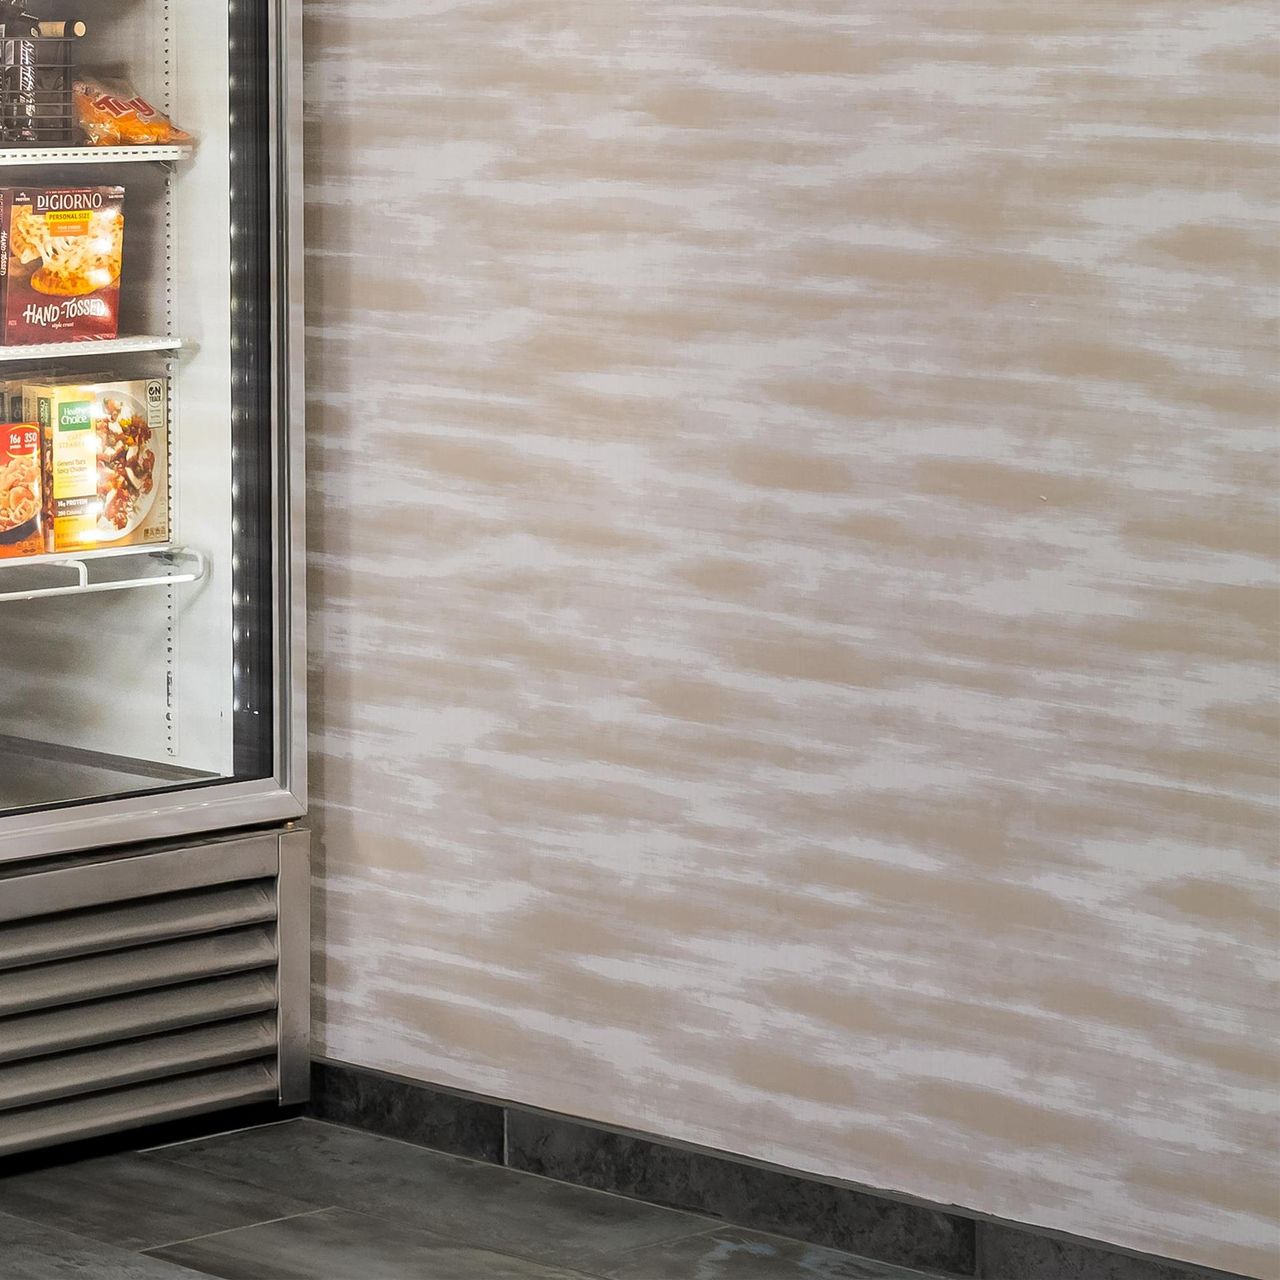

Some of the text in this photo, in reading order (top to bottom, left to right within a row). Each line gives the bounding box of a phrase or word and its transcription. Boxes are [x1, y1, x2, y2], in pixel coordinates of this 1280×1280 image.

[48, 212, 77, 220] PERSONAL
[61, 414, 88, 426] Choice
[24, 431, 38, 443] 350
